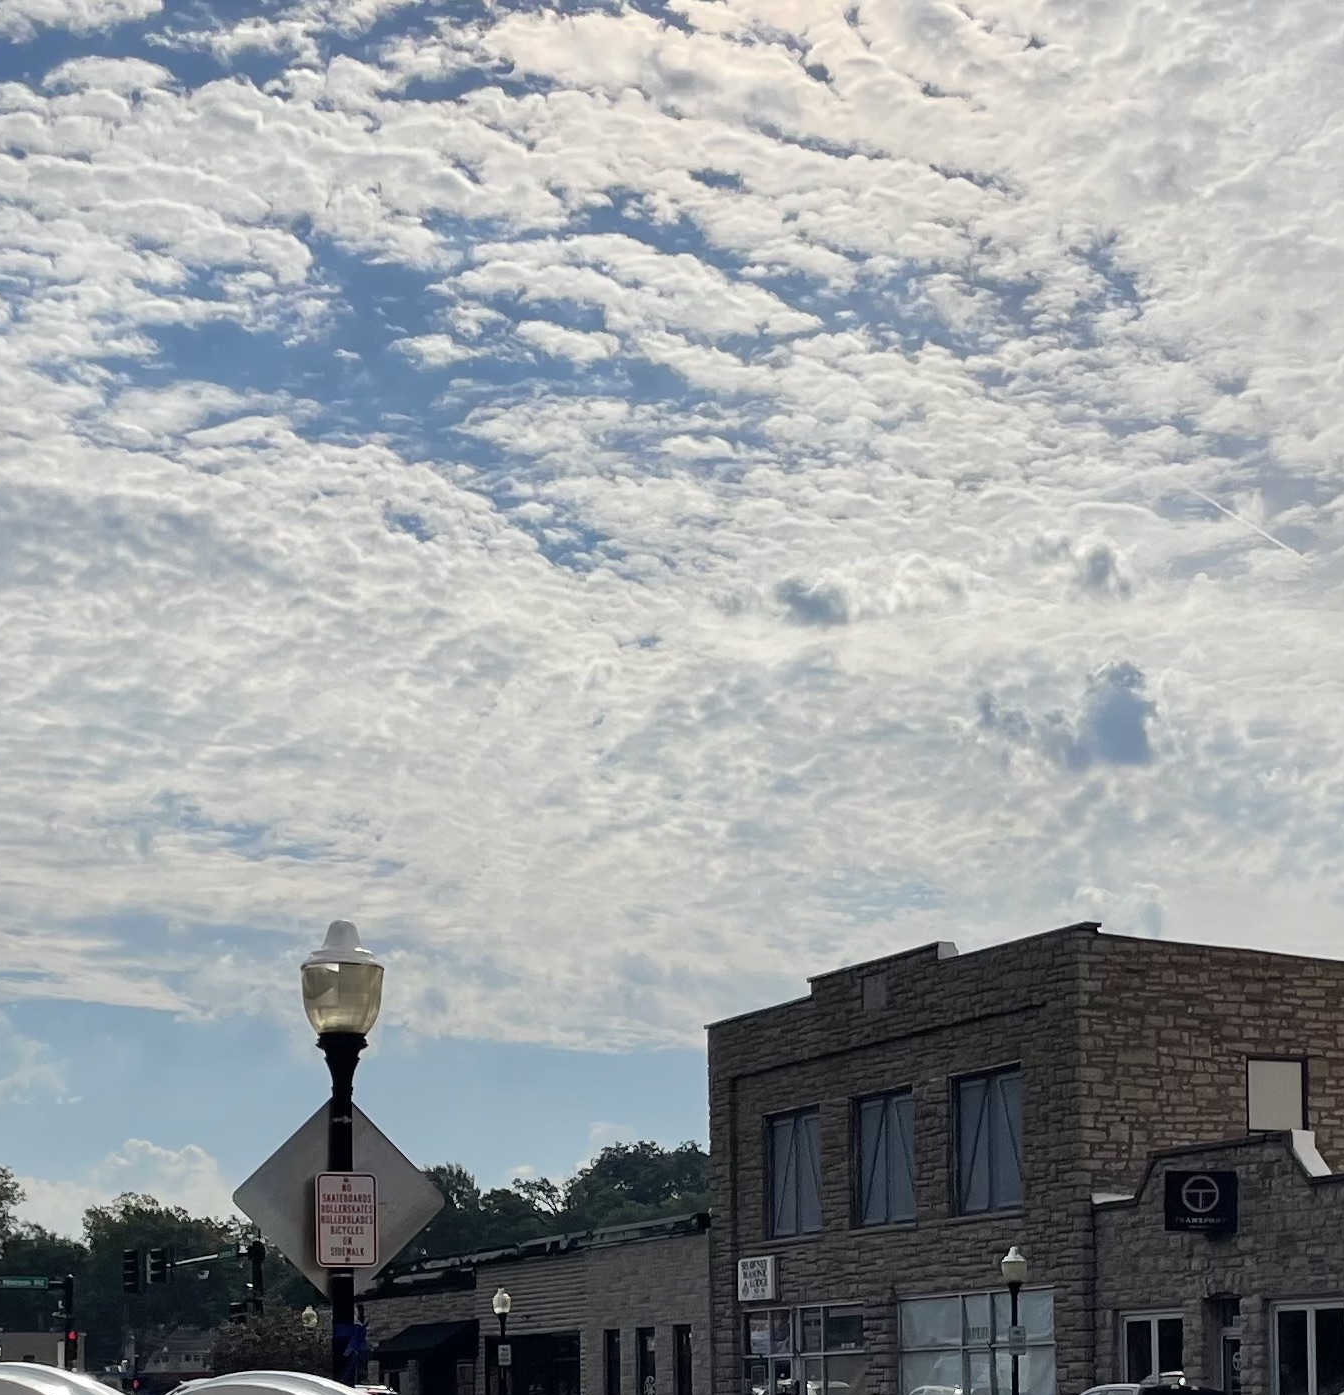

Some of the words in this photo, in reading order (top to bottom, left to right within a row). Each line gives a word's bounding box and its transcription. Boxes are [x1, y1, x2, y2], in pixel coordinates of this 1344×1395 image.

[342, 1183, 352, 1192] NO
[322, 1193, 372, 1203] SKATEBOARDS
[320, 1204, 373, 1214] ROLLERSKATES
[330, 1225, 365, 1235] BICYCLES
[342, 1236, 353, 1245] ON
[330, 1246, 365, 1256] SIDEWALK
